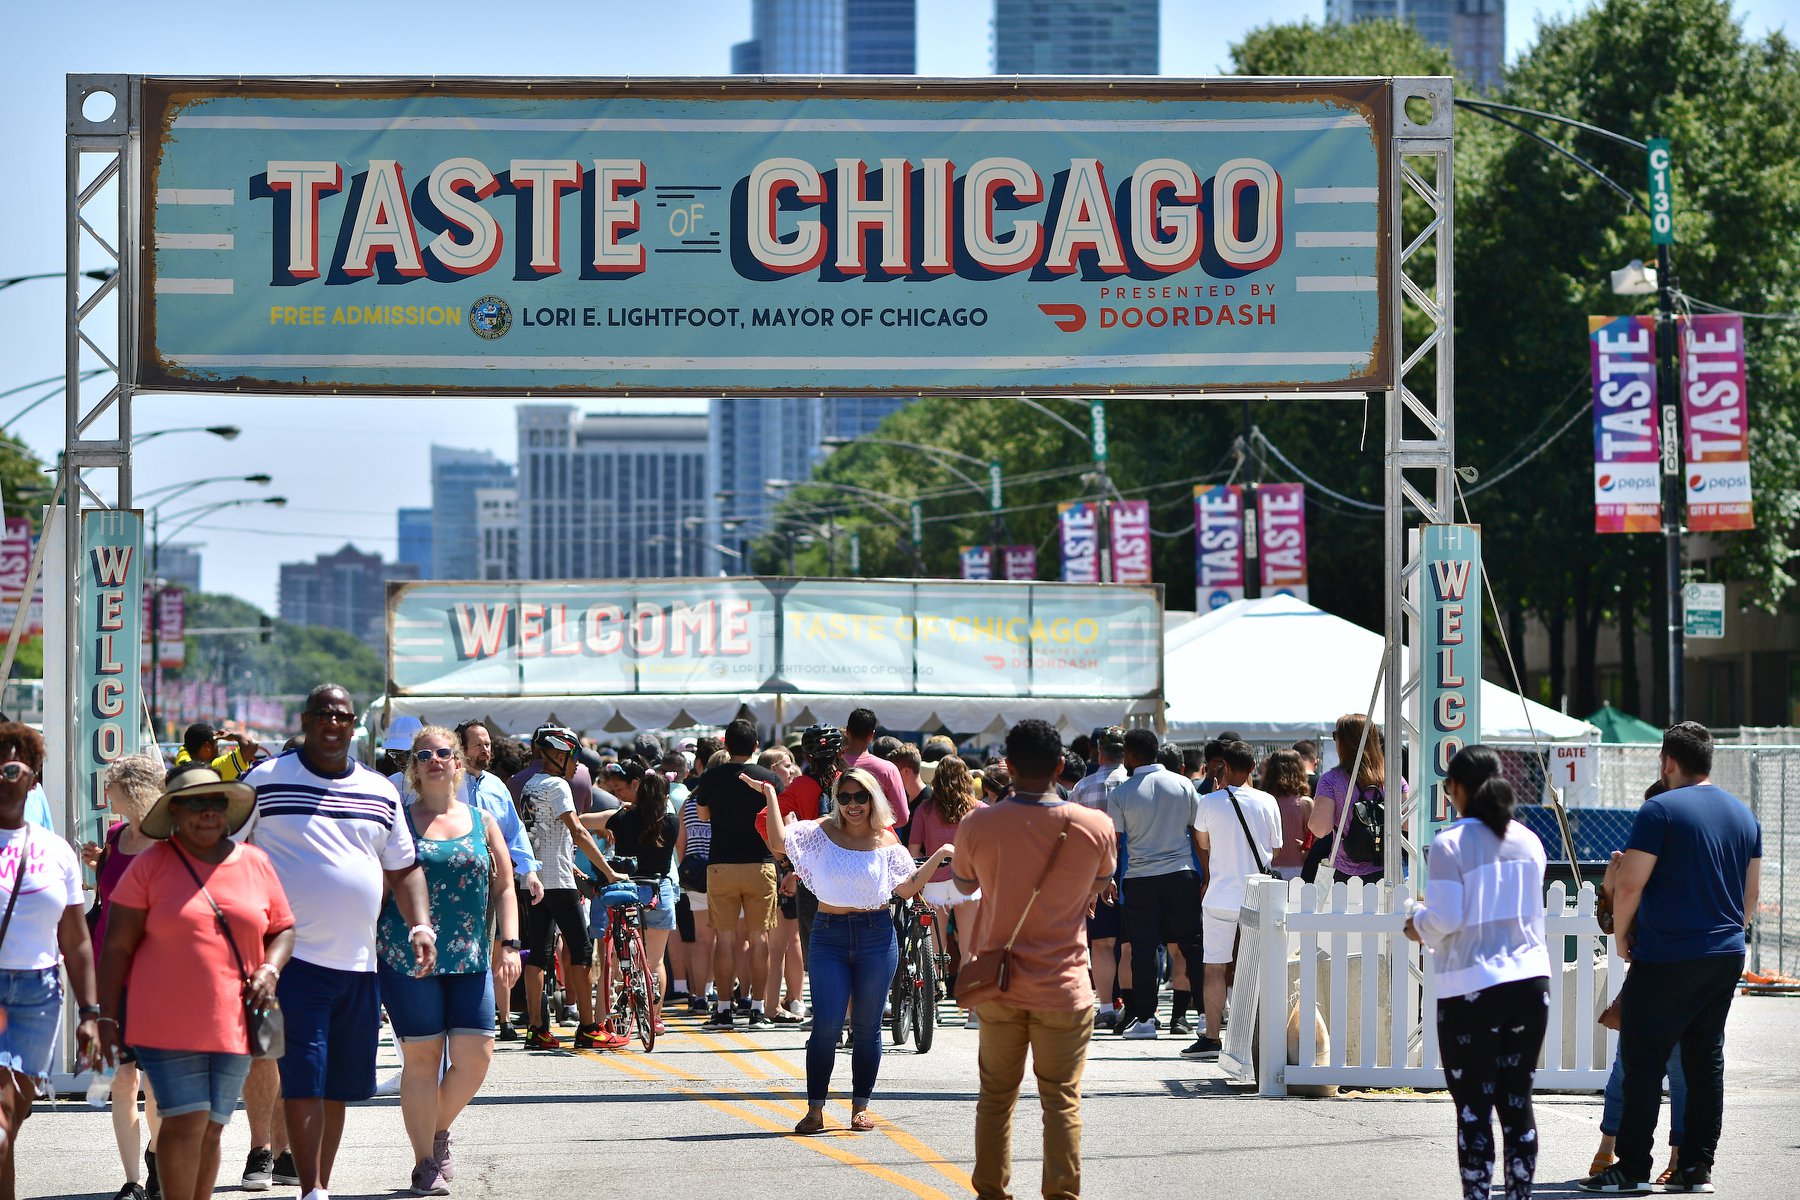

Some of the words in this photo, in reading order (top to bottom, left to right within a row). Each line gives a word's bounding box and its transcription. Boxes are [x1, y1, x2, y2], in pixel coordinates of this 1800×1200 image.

[258, 157, 650, 282] TASTE
[668, 203, 705, 237] OF
[738, 157, 1283, 280] CHICAGO
[1650, 148, 1671, 234] C130
[270, 306, 325, 325] FREE
[331, 306, 461, 326] ADMISSION
[522, 307, 576, 327] LORI
[583, 308, 601, 326] E.
[608, 307, 746, 329] LIGHTFOOT,
[752, 307, 835, 328] MAYOR
[841, 307, 874, 327] OF
[879, 308, 989, 328] CHICAGO
[1100, 285, 1235, 299] PRESENTED
[1251, 284, 1275, 296] BY
[1100, 304, 1276, 328] DOORDASH
[1598, 328, 1652, 461] TASTE
[1688, 327, 1742, 461] TASTE
[1664, 408, 1678, 471] C130
[1618, 474, 1656, 490] pepsi
[1709, 473, 1747, 490] pepsi
[1063, 509, 1096, 583] TASTE
[1113, 507, 1149, 583] TASTE
[1200, 493, 1239, 586] TASTE
[1262, 492, 1303, 585] TASTE
[450, 599, 751, 657] WELCOME
[789, 612, 886, 641] TASTE
[894, 616, 940, 642] OF
[949, 616, 1099, 644] CHICAGO
[1557, 747, 1587, 759] GATE
[1566, 761, 1576, 783] 1
